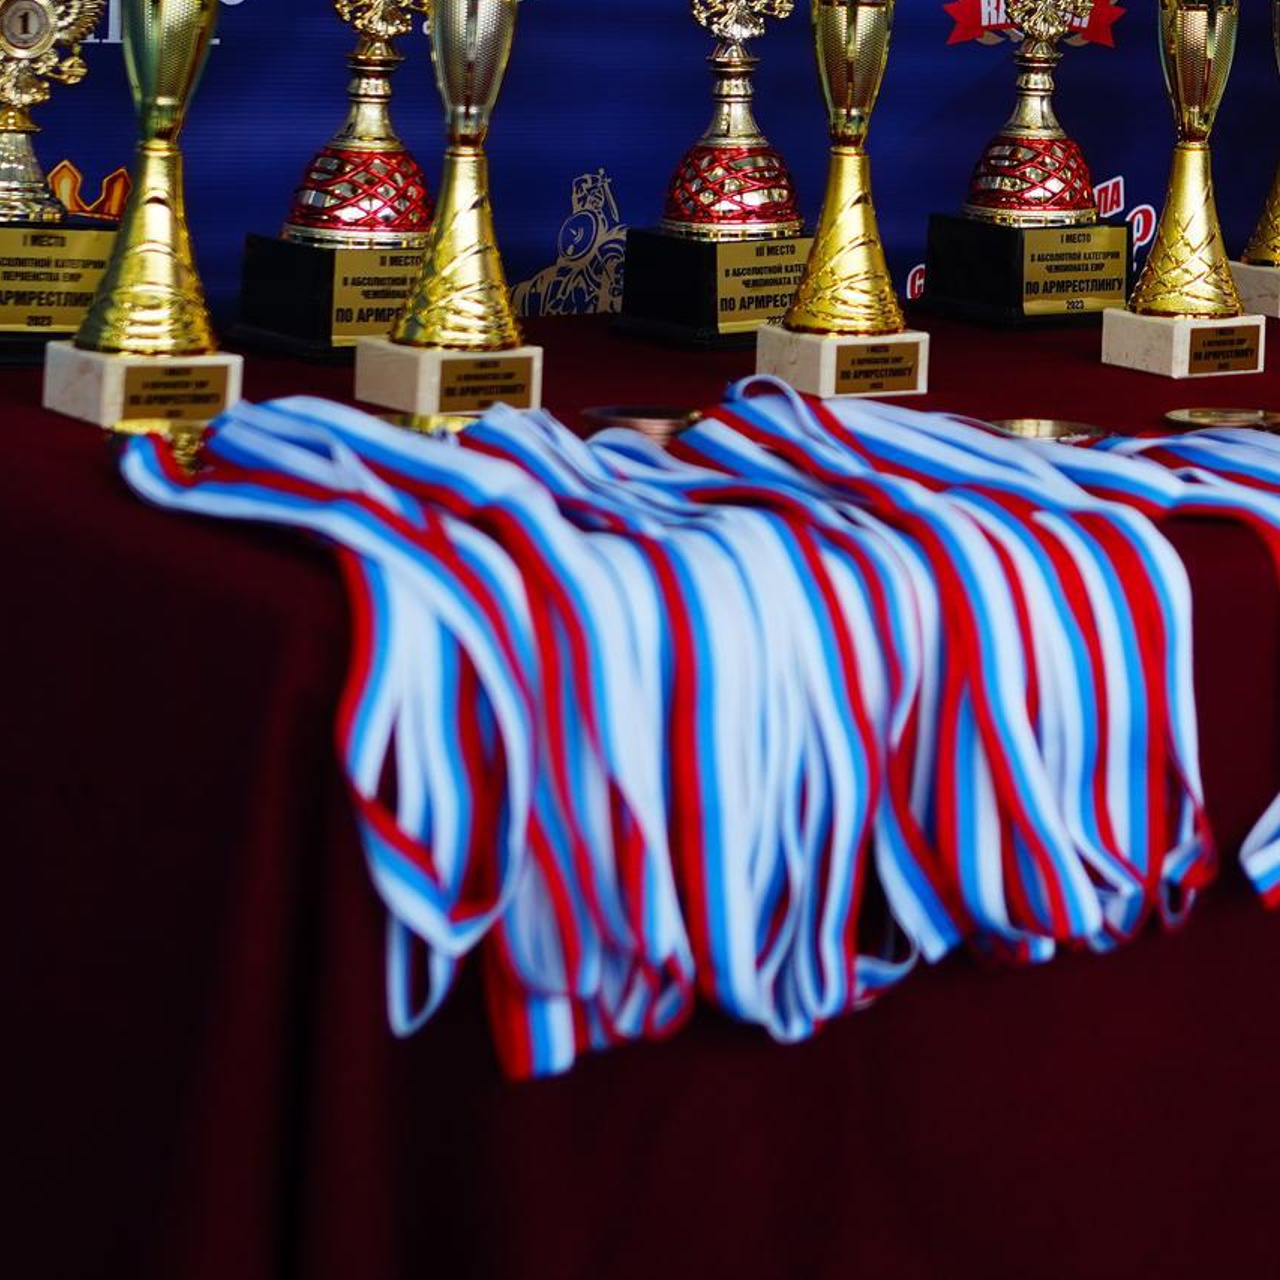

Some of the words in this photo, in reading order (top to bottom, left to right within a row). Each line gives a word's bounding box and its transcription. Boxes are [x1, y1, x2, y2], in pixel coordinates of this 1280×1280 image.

[1065, 233, 1092, 244] МЕСТО
[766, 244, 796, 257] МЕСТО
[1025, 281, 1040, 295] ПО
[1042, 277, 1124, 294] АРМРЕСТЛИНГУ
[720, 297, 736, 312] ПО
[335, 307, 354, 323] ПО
